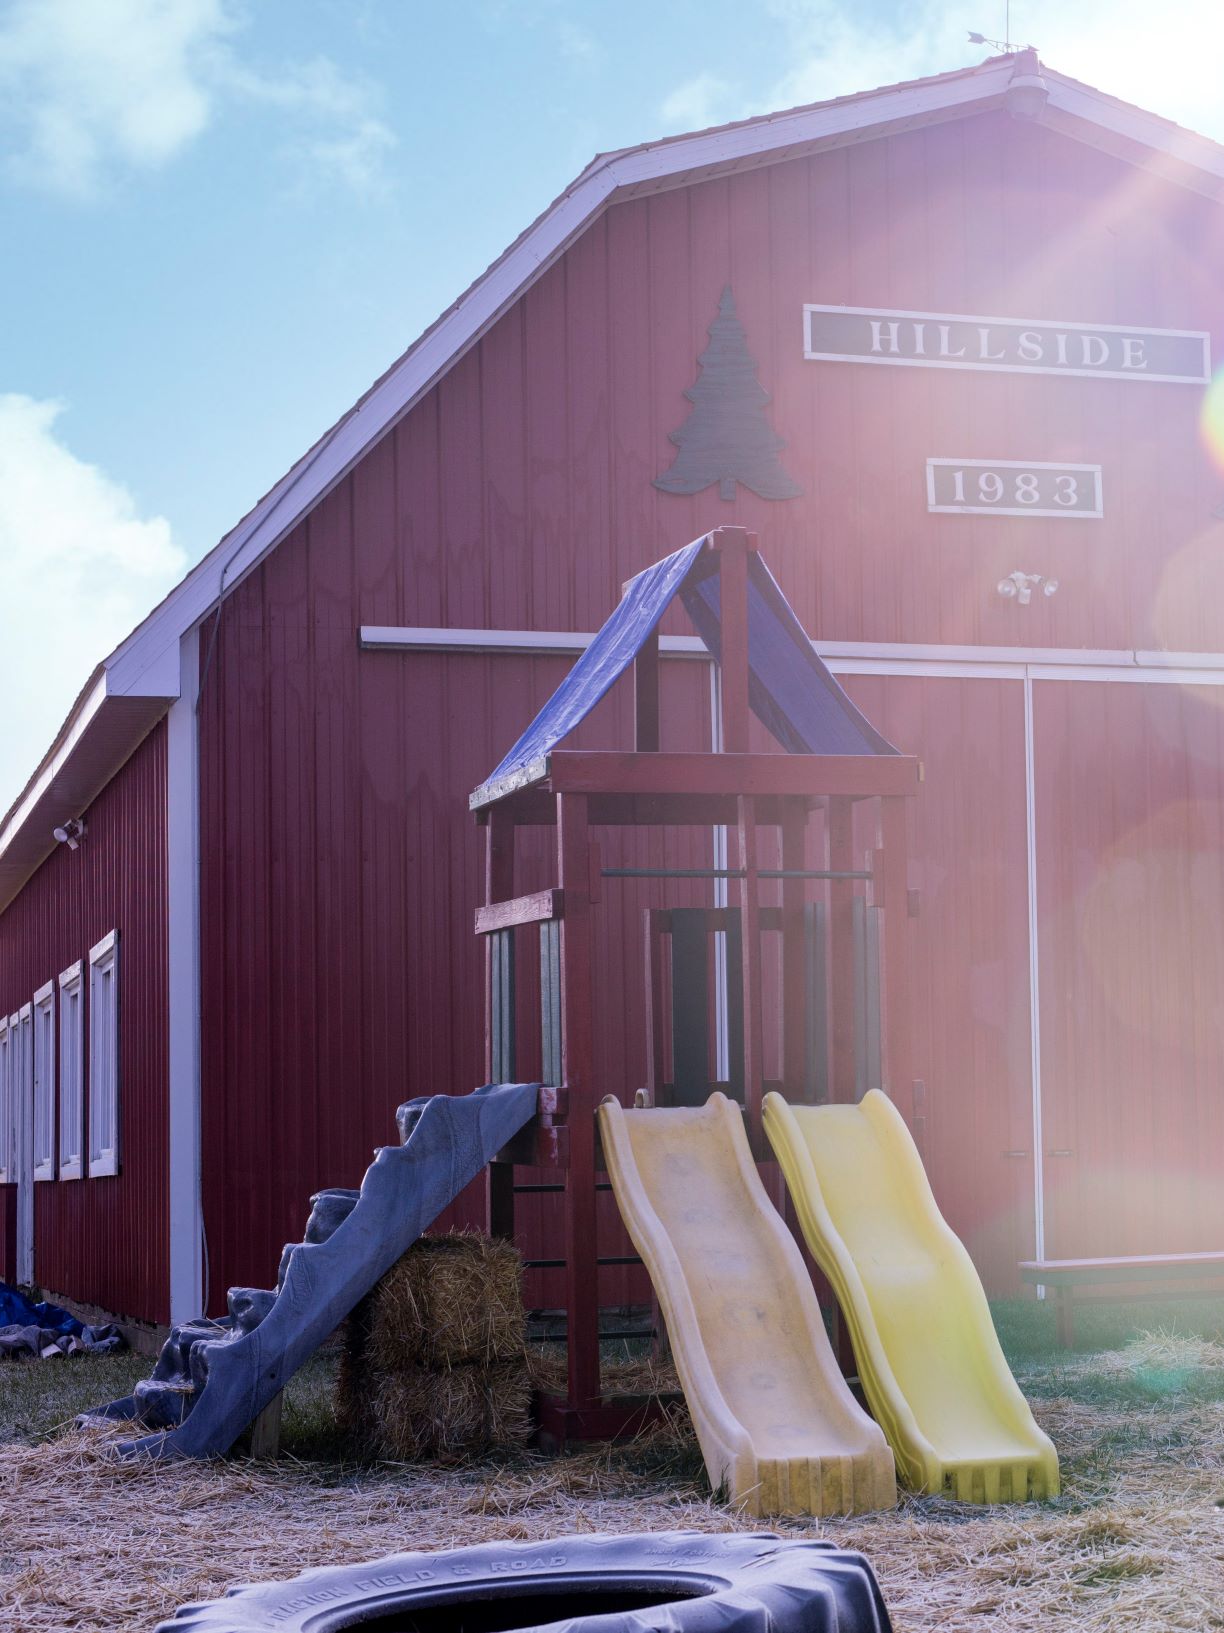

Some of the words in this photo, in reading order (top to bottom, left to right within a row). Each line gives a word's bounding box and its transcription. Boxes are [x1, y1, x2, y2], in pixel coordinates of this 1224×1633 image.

[869, 321, 1148, 369] HILLSIDE
[952, 471, 1078, 506] 1983
[354, 1569, 436, 1592] FIELD
[489, 1556, 569, 1573] ROAD
